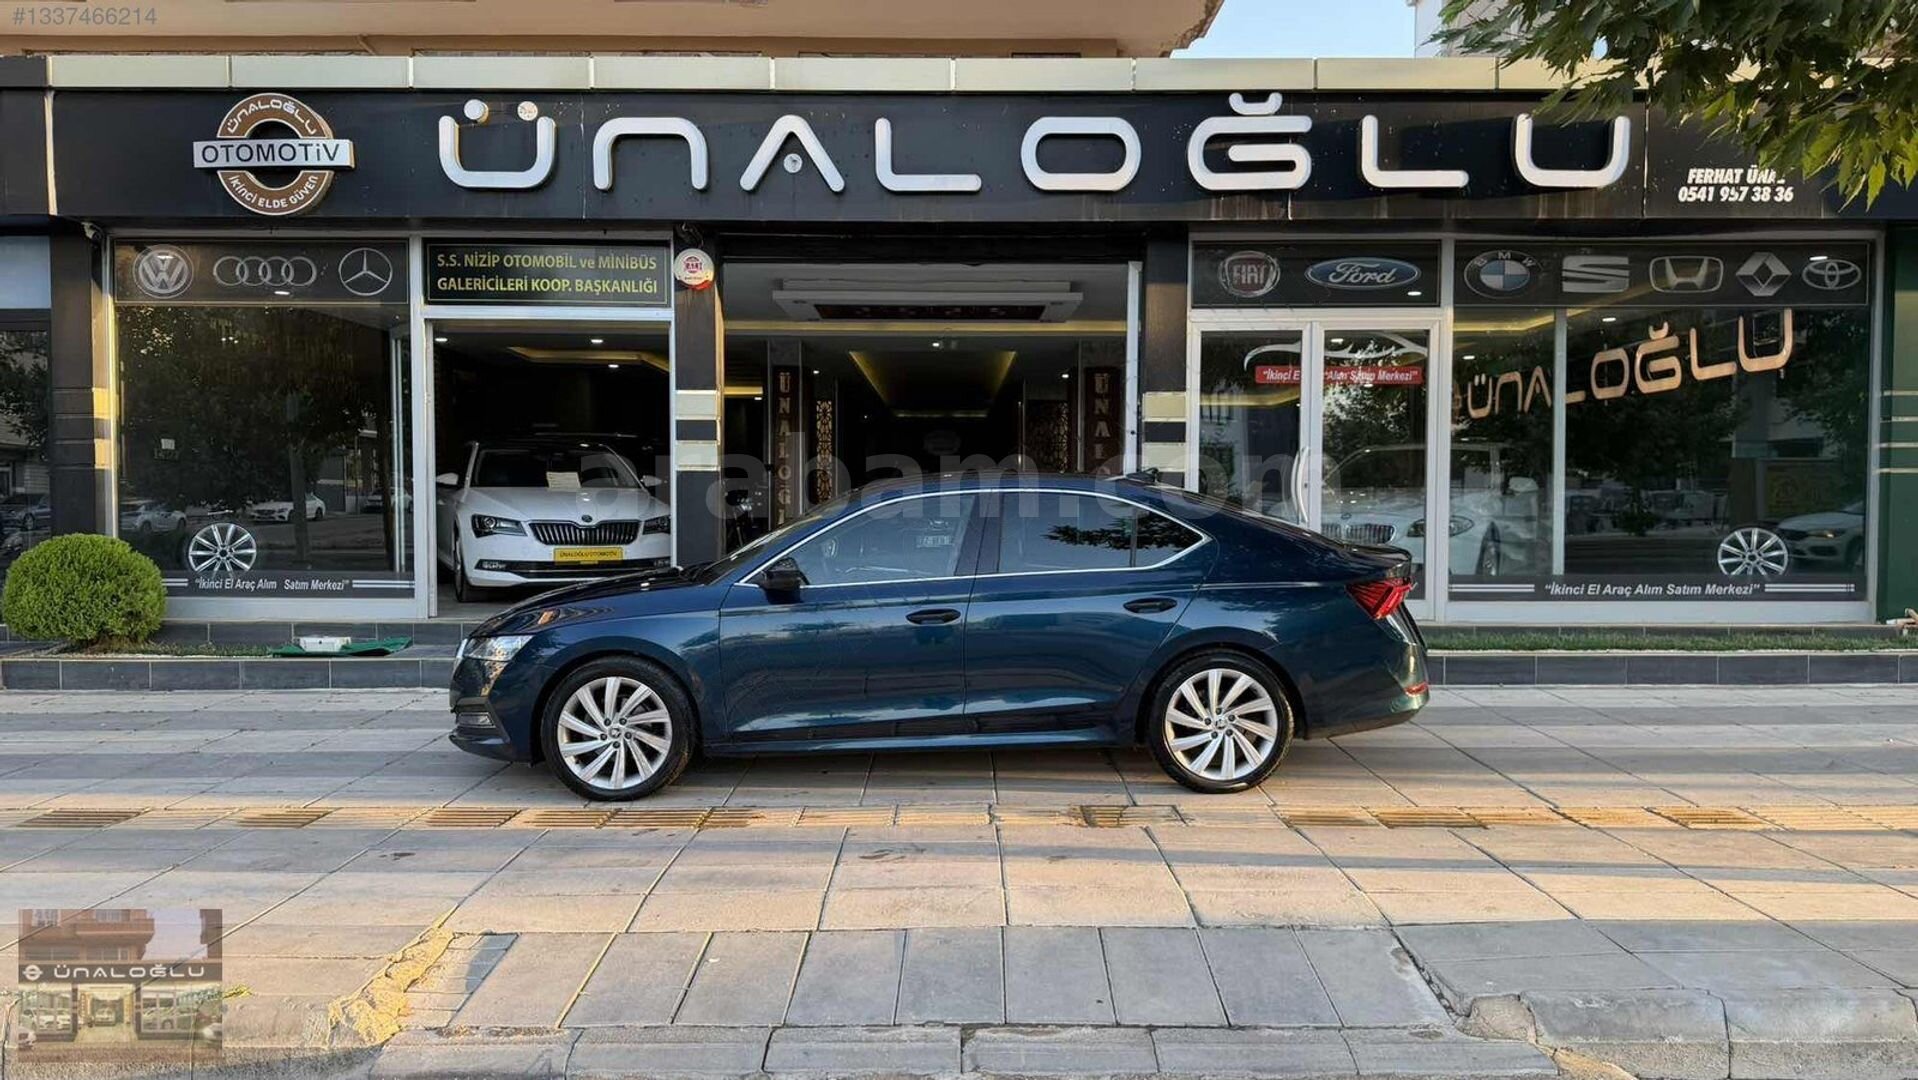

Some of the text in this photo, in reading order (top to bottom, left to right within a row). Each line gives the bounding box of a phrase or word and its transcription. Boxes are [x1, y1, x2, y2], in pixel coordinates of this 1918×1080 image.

[226, 98, 317, 135] ÜNALOĞLU
[439, 92, 1631, 191] ÜNALOĞLU
[1686, 167, 1744, 185] FERHAT
[257, 198, 288, 209] ELDE
[288, 174, 319, 205] GÜVEN
[1677, 185, 1795, 202] 0541 957 38 36
[437, 251, 657, 270] S.S. NİZİP OTOMOBİL ve MİNİBÜS
[1232, 263, 1268, 285] FIAT
[1328, 261, 1398, 285] Ford
[437, 275, 658, 296] GALERİCİLERİ KOOP. BAŞKANLIĞI
[777, 371, 793, 526] ÜNALOĞL
[224, 578, 234, 590] El
[234, 578, 256, 592] Araç
[256, 578, 278, 590] Alım
[283, 578, 309, 591] Satım
[1586, 583, 1601, 596] El
[1602, 583, 1633, 598] Araç
[1633, 583, 1664, 596] Alım
[1666, 583, 1702, 596] Satım
